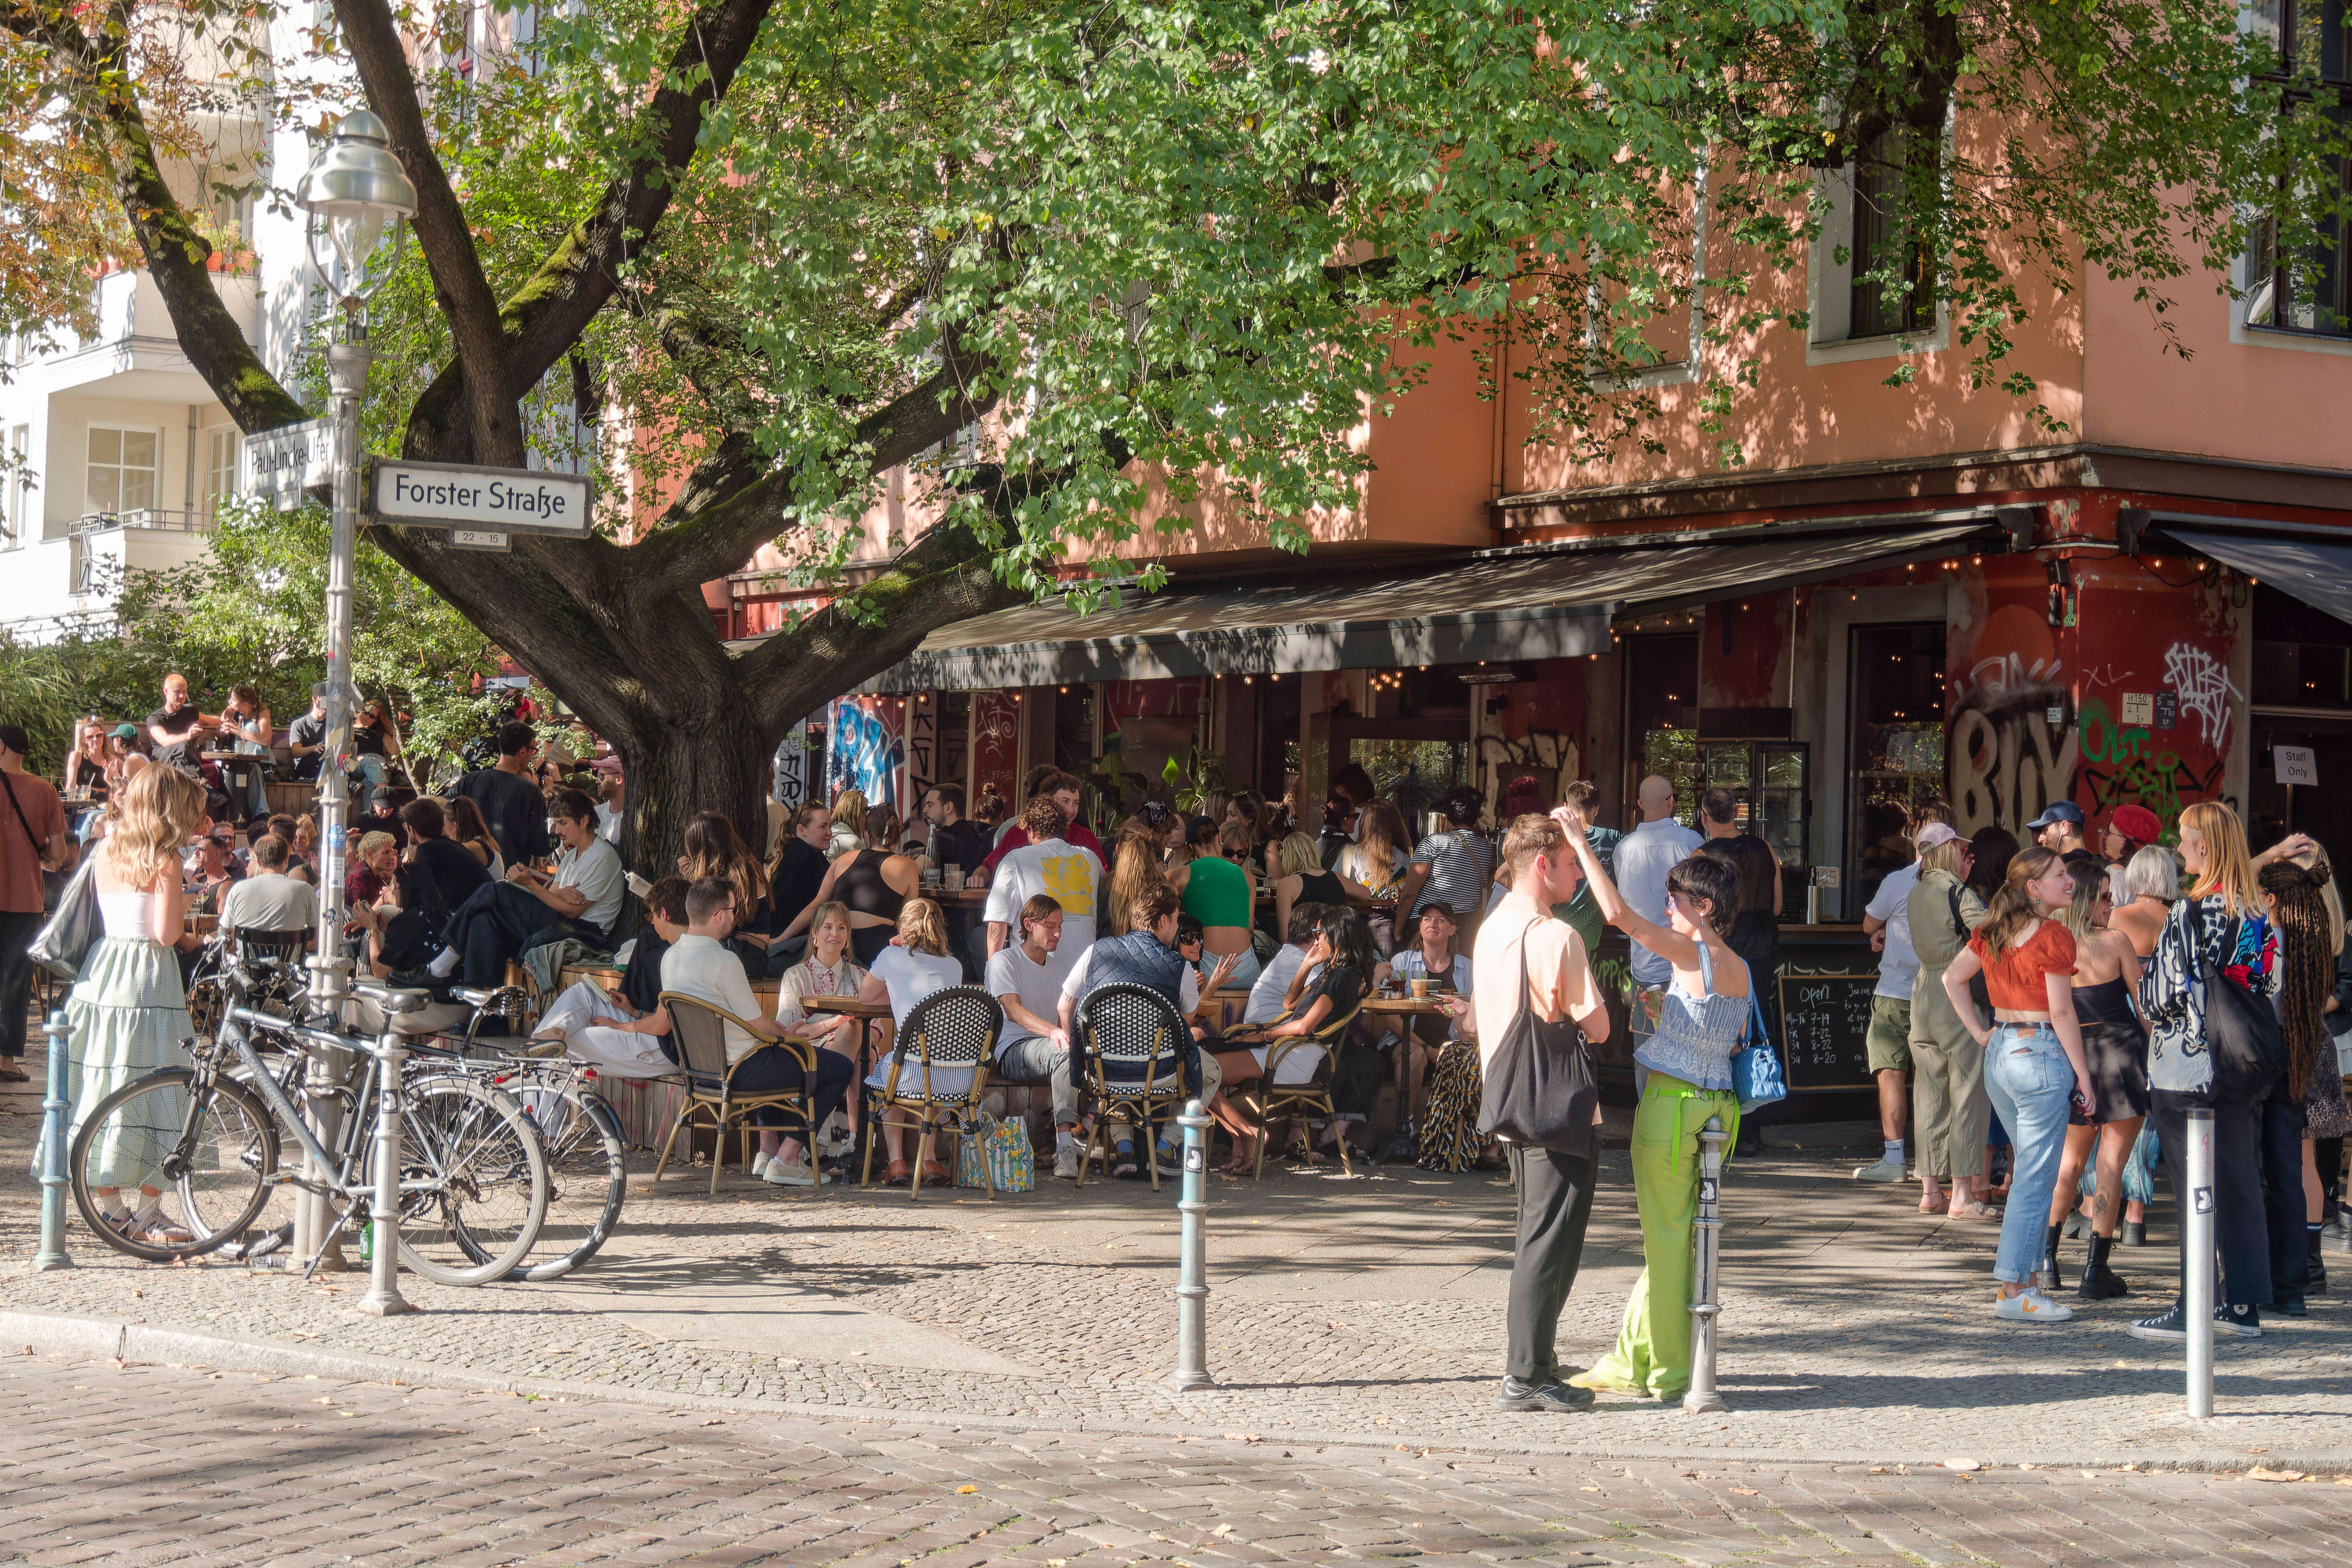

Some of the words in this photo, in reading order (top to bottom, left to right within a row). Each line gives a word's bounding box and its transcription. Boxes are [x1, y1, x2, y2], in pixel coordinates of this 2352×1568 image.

[252, 434, 330, 476] Paul-Lincke-Ufer
[396, 474, 481, 508] Forster
[489, 481, 565, 519] Straße
[463, 533, 475, 541] 22
[489, 534, 499, 543] 15
[940, 663, 949, 686] LA
[952, 662, 983, 686] MAISON
[2286, 751, 2306, 761] Staff
[2288, 767, 2307, 779] Only
[1800, 985, 1829, 1009] Open
[1791, 1053, 1800, 1064] Su
[1813, 1052, 1836, 1063] 8-20
